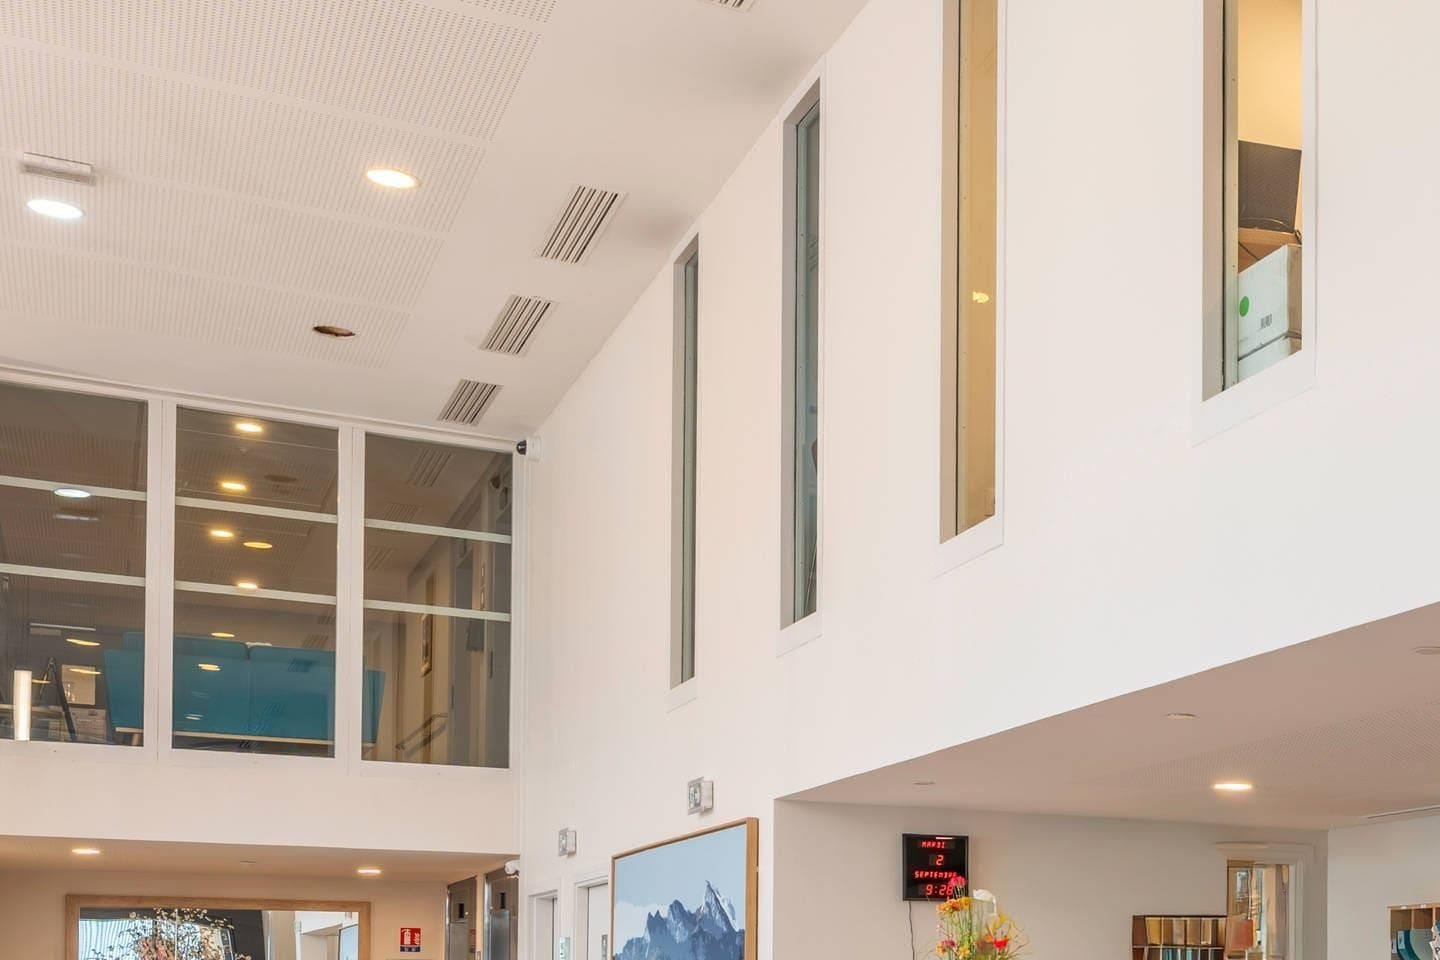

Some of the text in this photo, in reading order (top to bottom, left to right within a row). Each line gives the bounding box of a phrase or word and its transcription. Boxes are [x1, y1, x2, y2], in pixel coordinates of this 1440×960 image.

[921, 841, 945, 849] MARDI
[935, 854, 944, 866] 2
[926, 883, 954, 896] 9:28
